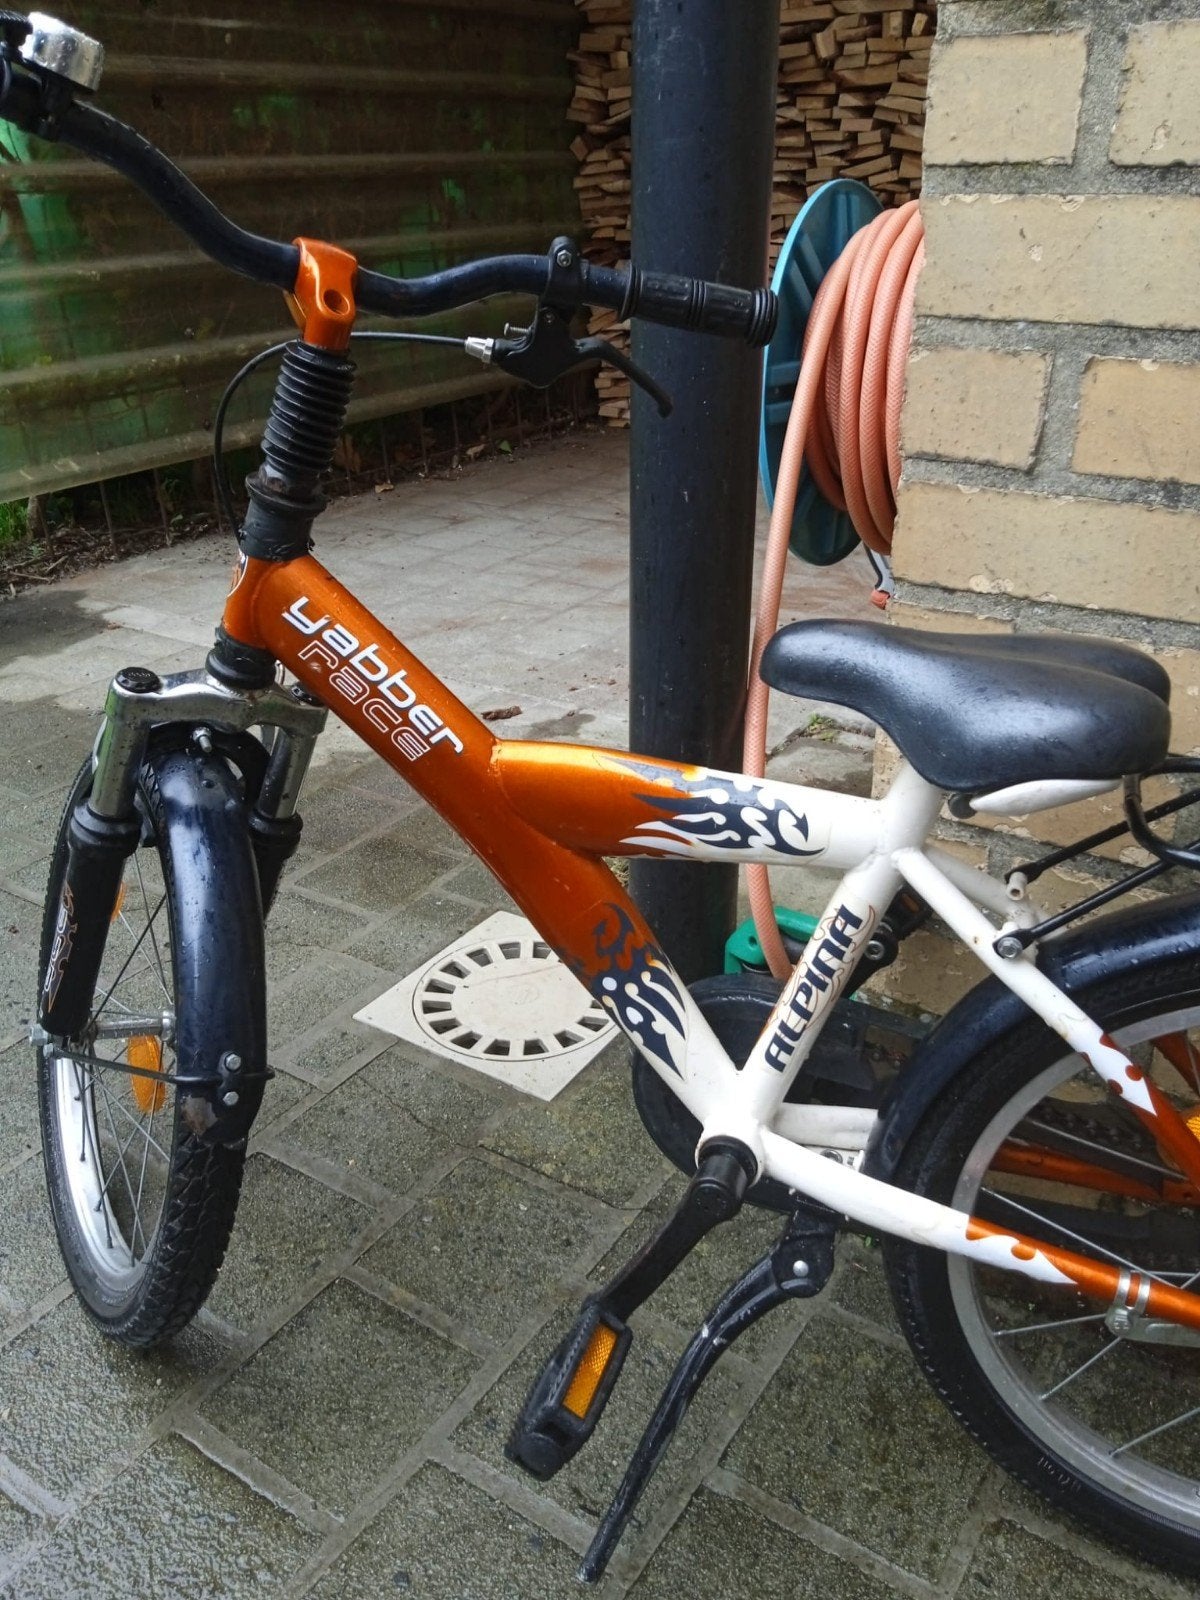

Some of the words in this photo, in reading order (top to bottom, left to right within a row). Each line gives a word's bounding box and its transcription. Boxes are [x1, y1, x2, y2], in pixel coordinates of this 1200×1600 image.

[281, 596, 464, 754] yabber
[298, 640, 431, 762] race
[764, 904, 863, 1073] ALPINA
